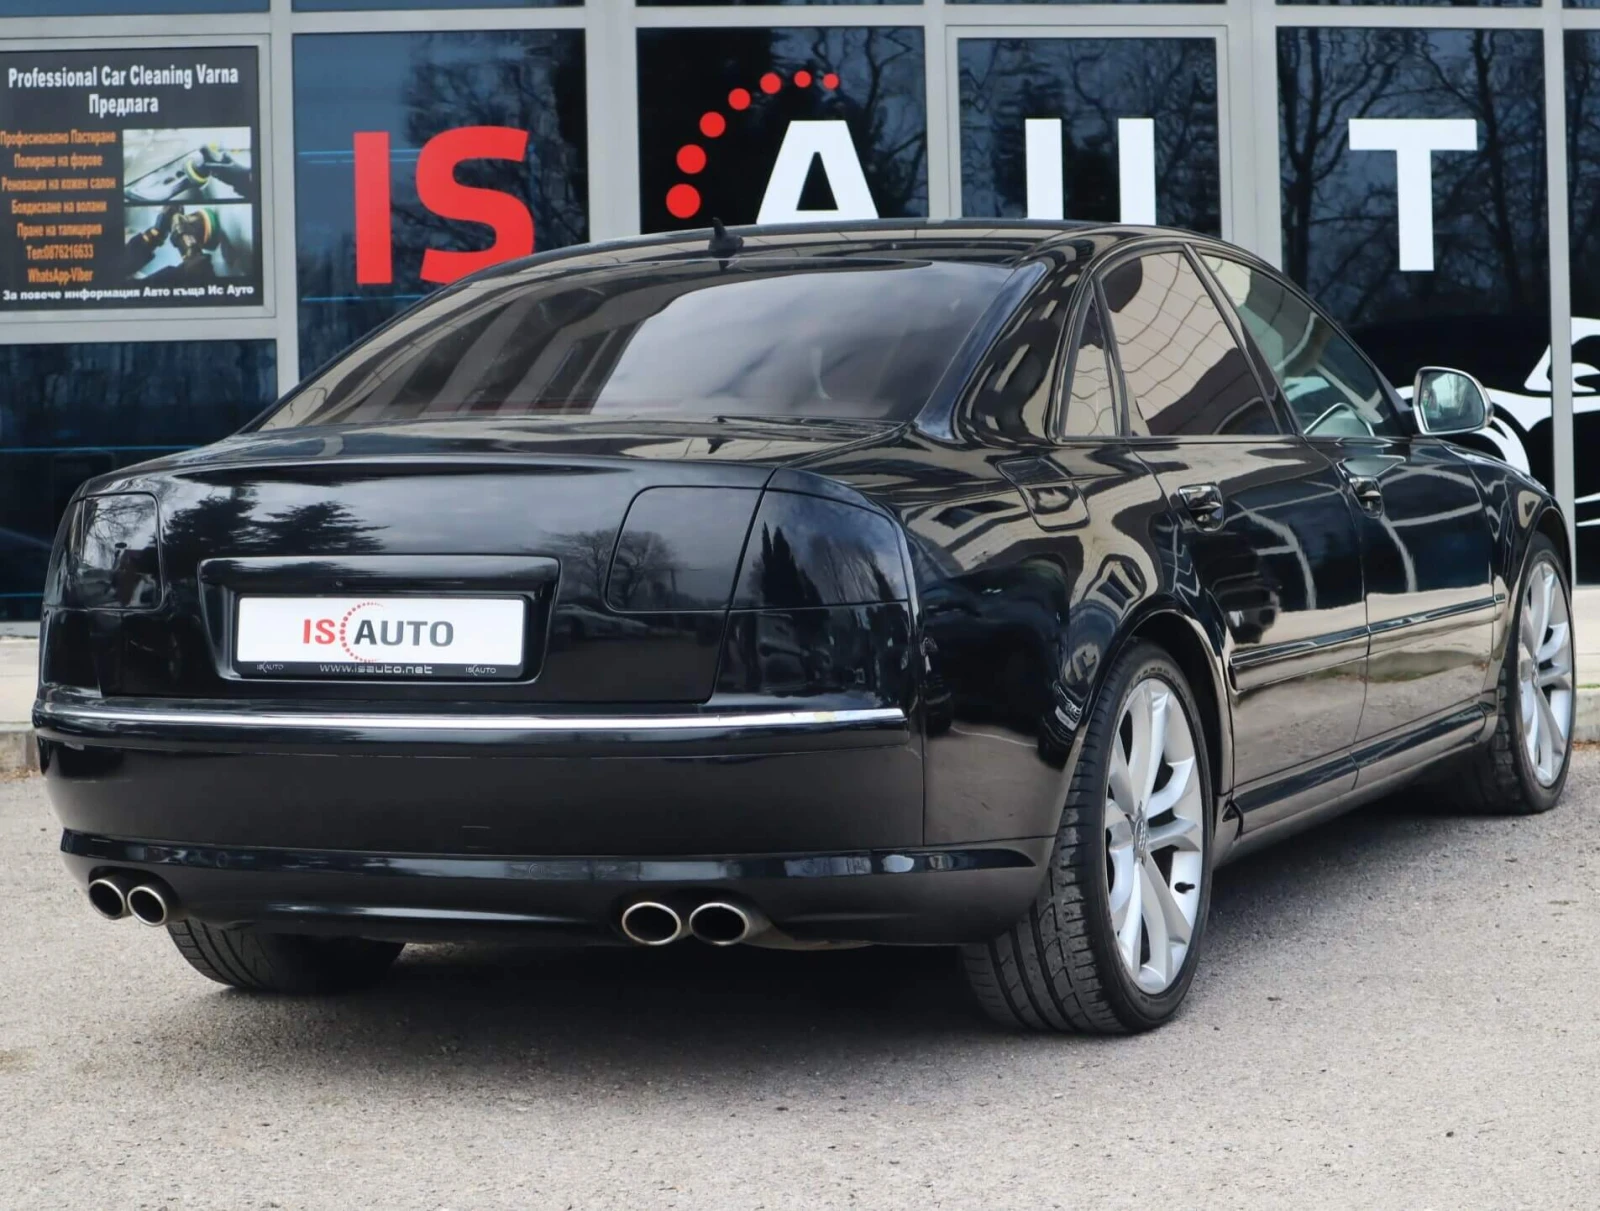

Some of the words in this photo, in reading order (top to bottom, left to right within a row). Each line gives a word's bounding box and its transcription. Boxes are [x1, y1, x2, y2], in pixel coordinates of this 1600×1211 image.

[8, 67, 98, 88] Professional
[101, 66, 126, 86] Car
[130, 65, 193, 89] Cleaning
[196, 64, 239, 84] Varna
[89, 94, 159, 118] Предлага
[353, 125, 535, 285] IS
[3, 290, 17, 300] За
[20, 289, 61, 300] повече
[64, 288, 140, 300] информация
[143, 287, 170, 297] Авто
[172, 286, 205, 297] къща
[208, 285, 224, 295] Ис
[226, 284, 254, 295] Ауто
[303, 619, 336, 644] IS
[353, 619, 454, 647] AUTO
[319, 663, 433, 675] www.isauto.net
